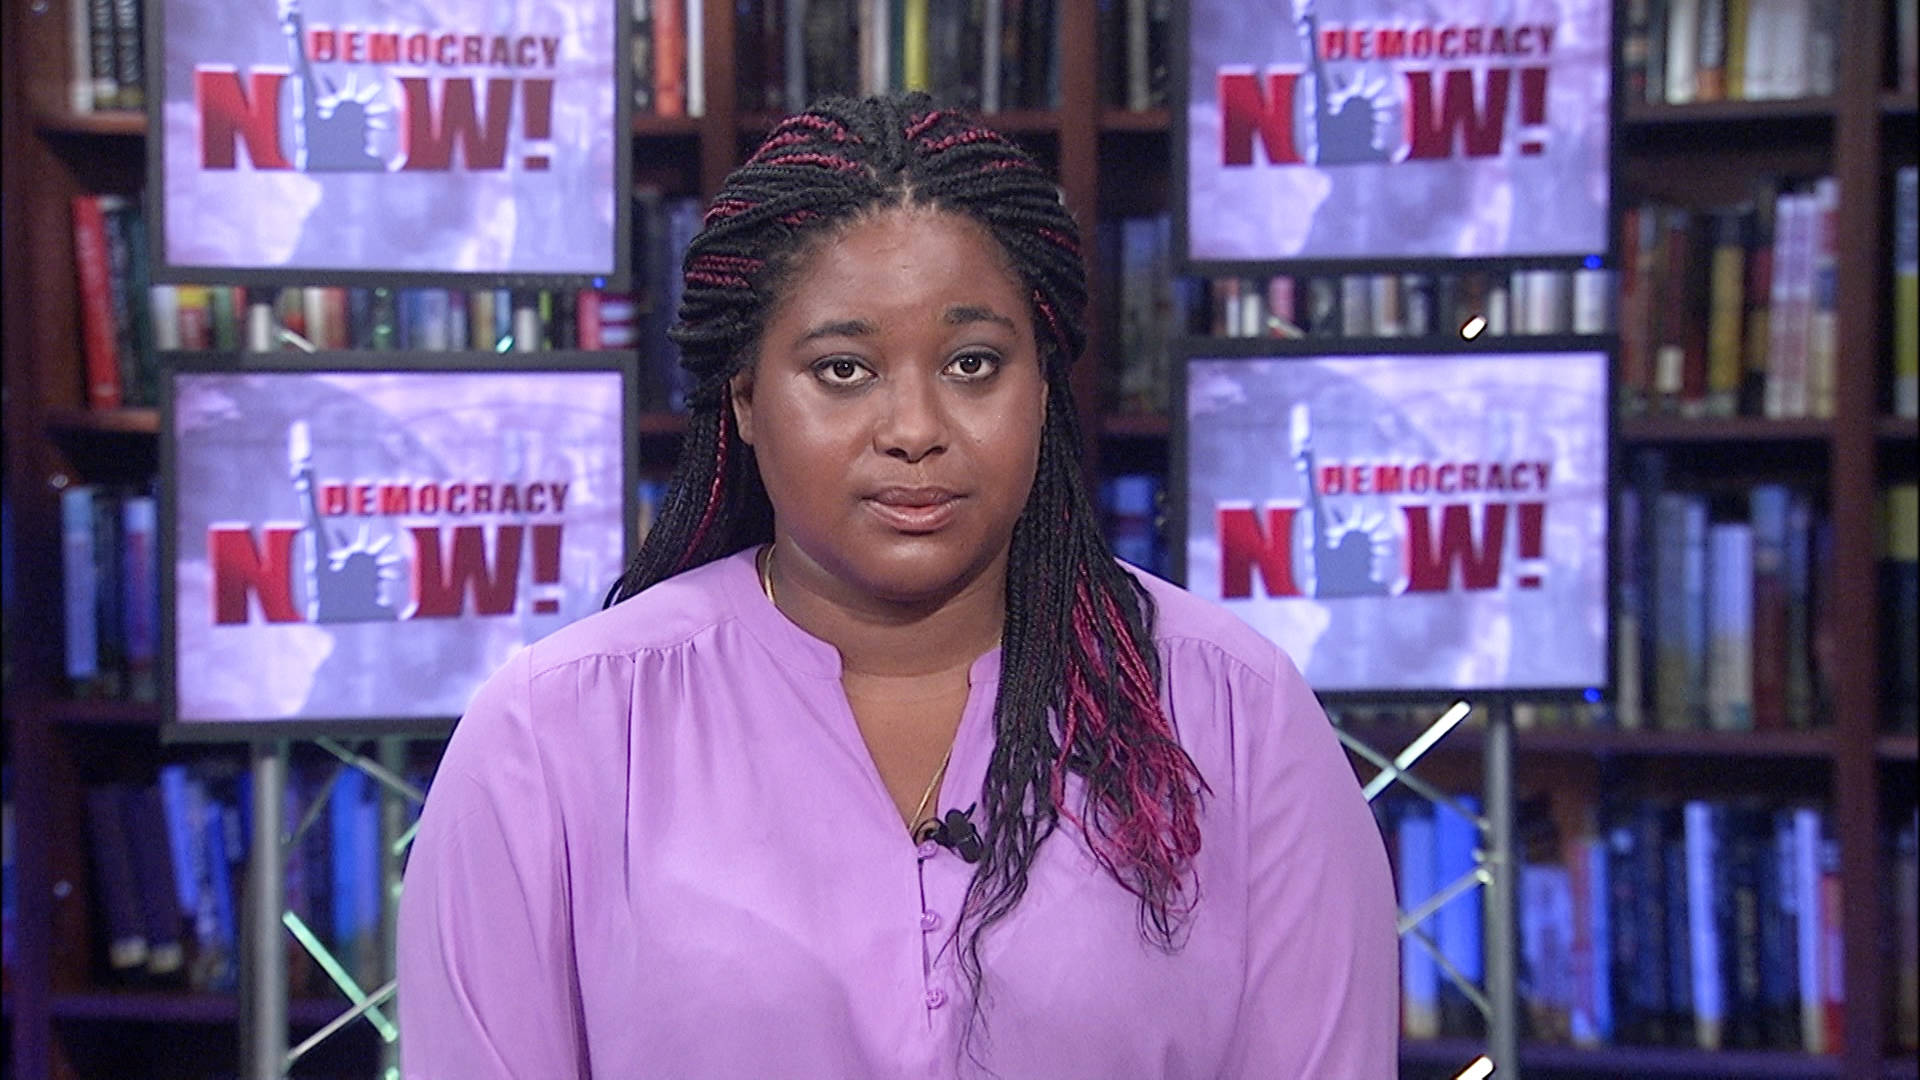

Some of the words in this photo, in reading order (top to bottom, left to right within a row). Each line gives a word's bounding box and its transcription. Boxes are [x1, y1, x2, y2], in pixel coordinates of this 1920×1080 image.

[308, 29, 560, 69] DEMOCRACY
[1320, 26, 1555, 60] DEMOCRACY
[1318, 462, 1551, 495] DEMOCRACY
[319, 480, 570, 516] DEMOCRACY
